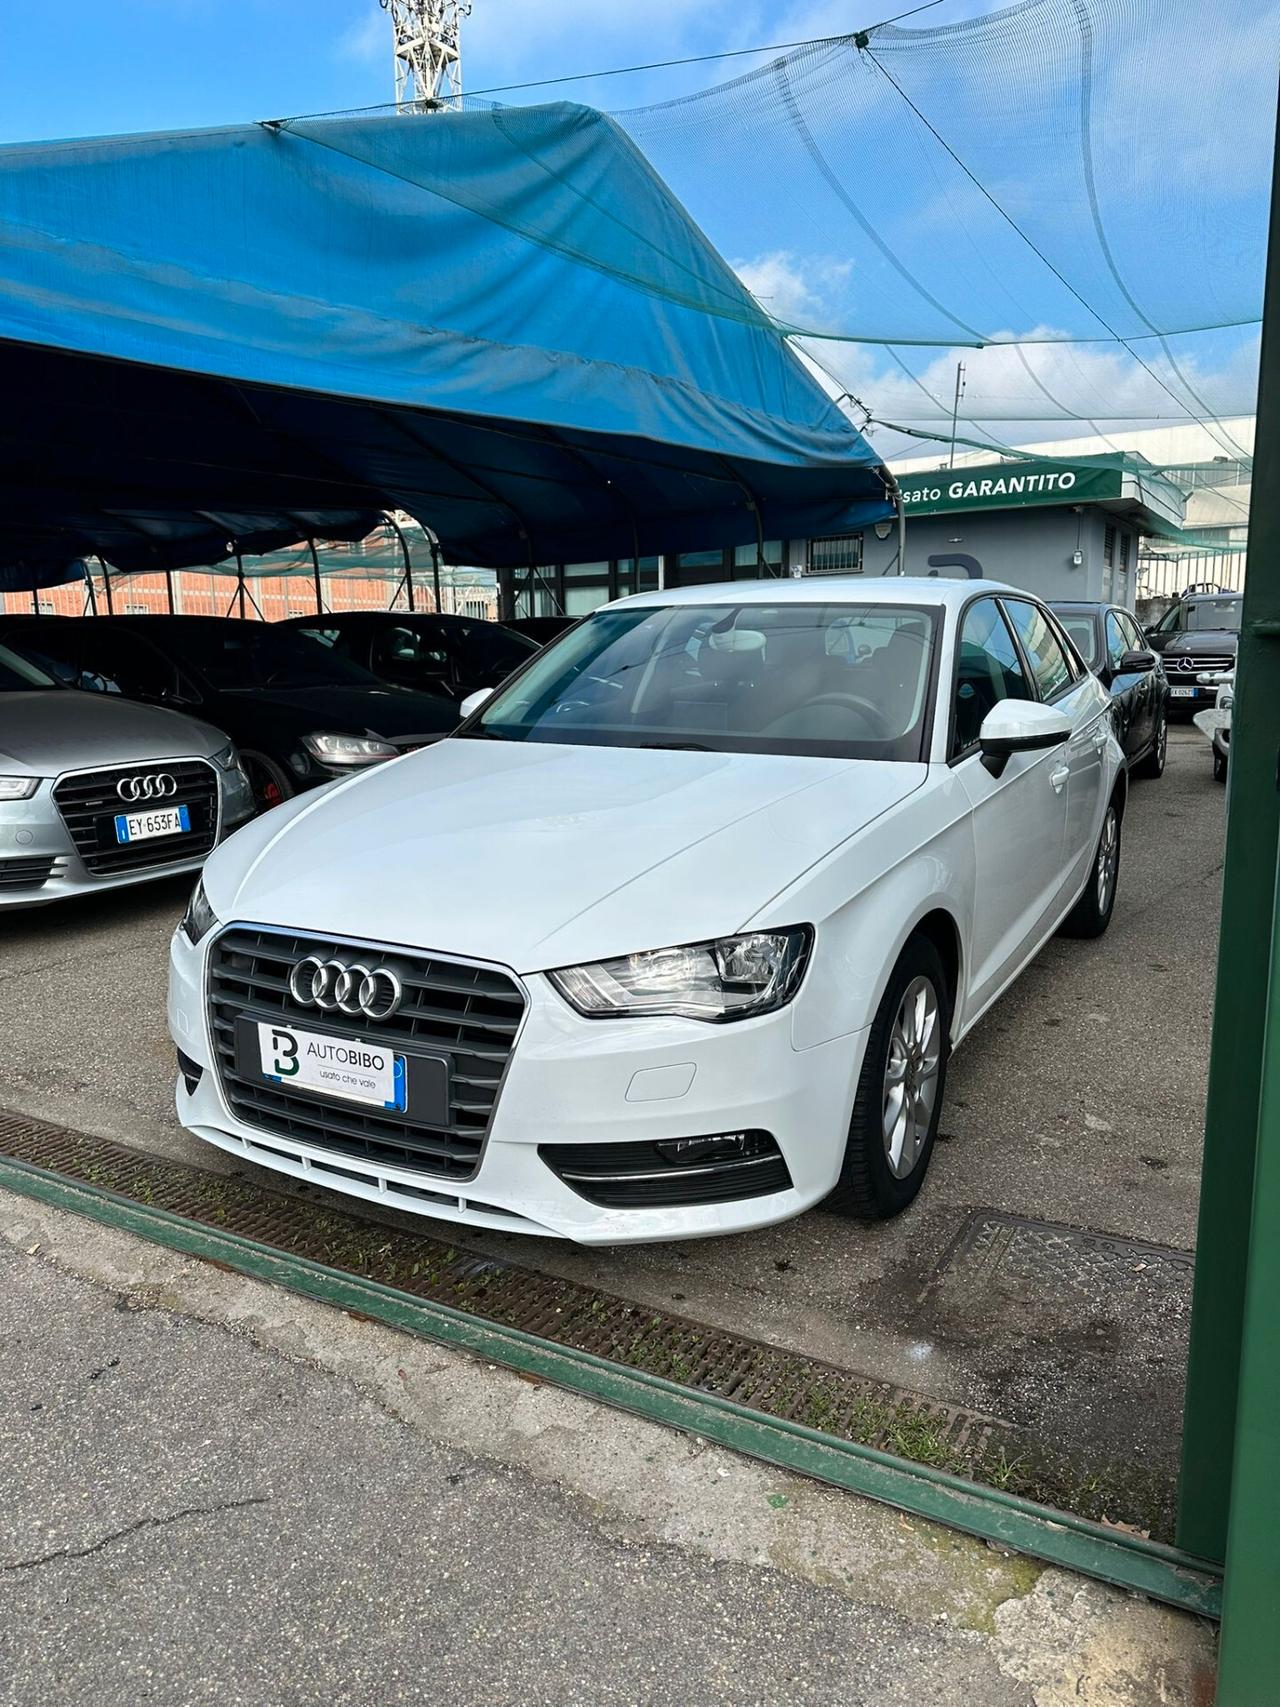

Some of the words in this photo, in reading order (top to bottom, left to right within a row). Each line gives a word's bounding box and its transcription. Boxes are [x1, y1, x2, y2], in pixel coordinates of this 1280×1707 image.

[898, 487, 942, 503] sato
[948, 472, 1076, 499] GARANTITO
[128, 818, 143, 835] EY
[146, 812, 181, 832] 653FA
[306, 1041, 385, 1071] AUTOBIBO
[319, 1069, 341, 1082] usato
[342, 1074, 358, 1086] che
[359, 1078, 377, 1089] vale
